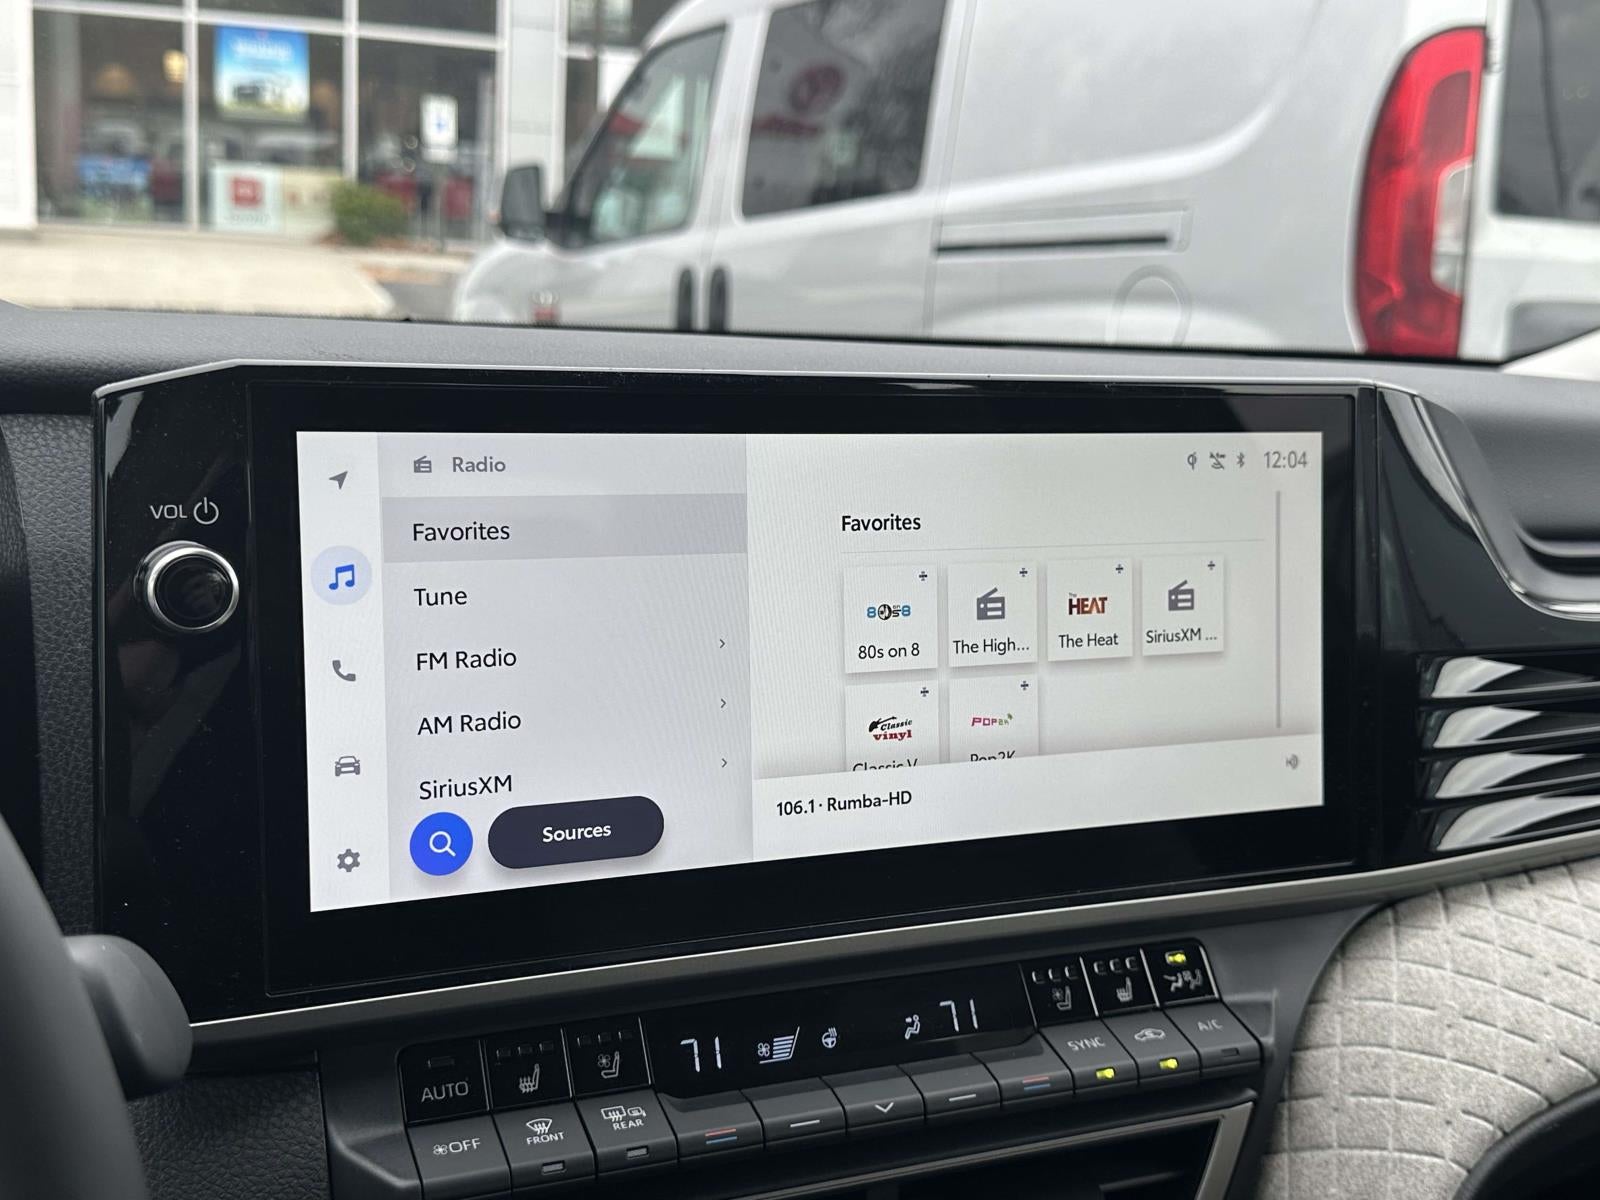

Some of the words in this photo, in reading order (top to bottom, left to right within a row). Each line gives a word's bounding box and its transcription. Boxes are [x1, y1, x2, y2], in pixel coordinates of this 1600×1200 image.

[452, 456, 506, 473] Radio
[1263, 450, 1308, 469] 12:04
[150, 504, 188, 519] VOL
[413, 521, 511, 542] Favorites
[841, 513, 922, 532] Favorites
[413, 587, 468, 607] Tune
[1068, 597, 1108, 616] HEAT
[1058, 634, 1084, 648] The
[1087, 632, 1119, 647] Heat
[1145, 627, 1202, 644] SiriusXM
[858, 644, 884, 660] 80s
[888, 647, 907, 658] on
[911, 642, 920, 656] 8
[952, 639, 980, 654] The
[416, 652, 448, 671] FM
[455, 648, 517, 669] Radio
[417, 716, 453, 736] AM
[460, 711, 522, 732] Radio
[873, 729, 913, 741] vinyl
[419, 774, 513, 800] SiriusXM
[776, 800, 815, 816] 106.1
[827, 790, 912, 811] Rumba-HD
[542, 824, 612, 843] Sources
[939, 999, 978, 1032] 71
[1197, 1019, 1223, 1032] A/C
[1067, 1036, 1105, 1051] SYNC
[680, 1036, 722, 1072] 71
[421, 1080, 469, 1102] AUTO
[612, 1119, 645, 1131] REAR
[449, 1138, 481, 1154] OFF
[526, 1131, 565, 1145] FRONT
